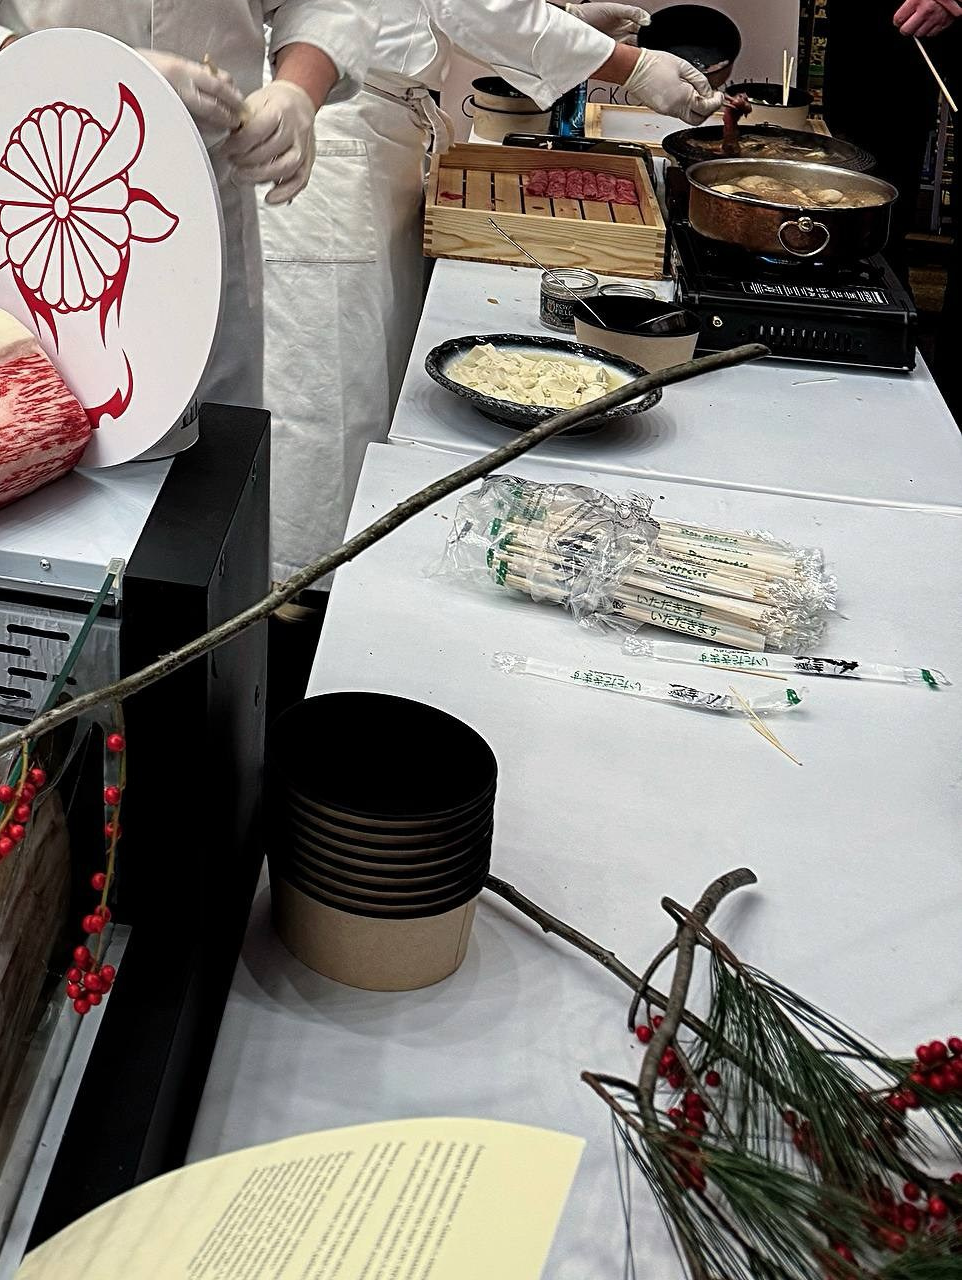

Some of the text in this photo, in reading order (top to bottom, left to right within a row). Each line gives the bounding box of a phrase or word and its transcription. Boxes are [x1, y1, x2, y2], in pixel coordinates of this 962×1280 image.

[650, 610, 721, 637] いただきます
